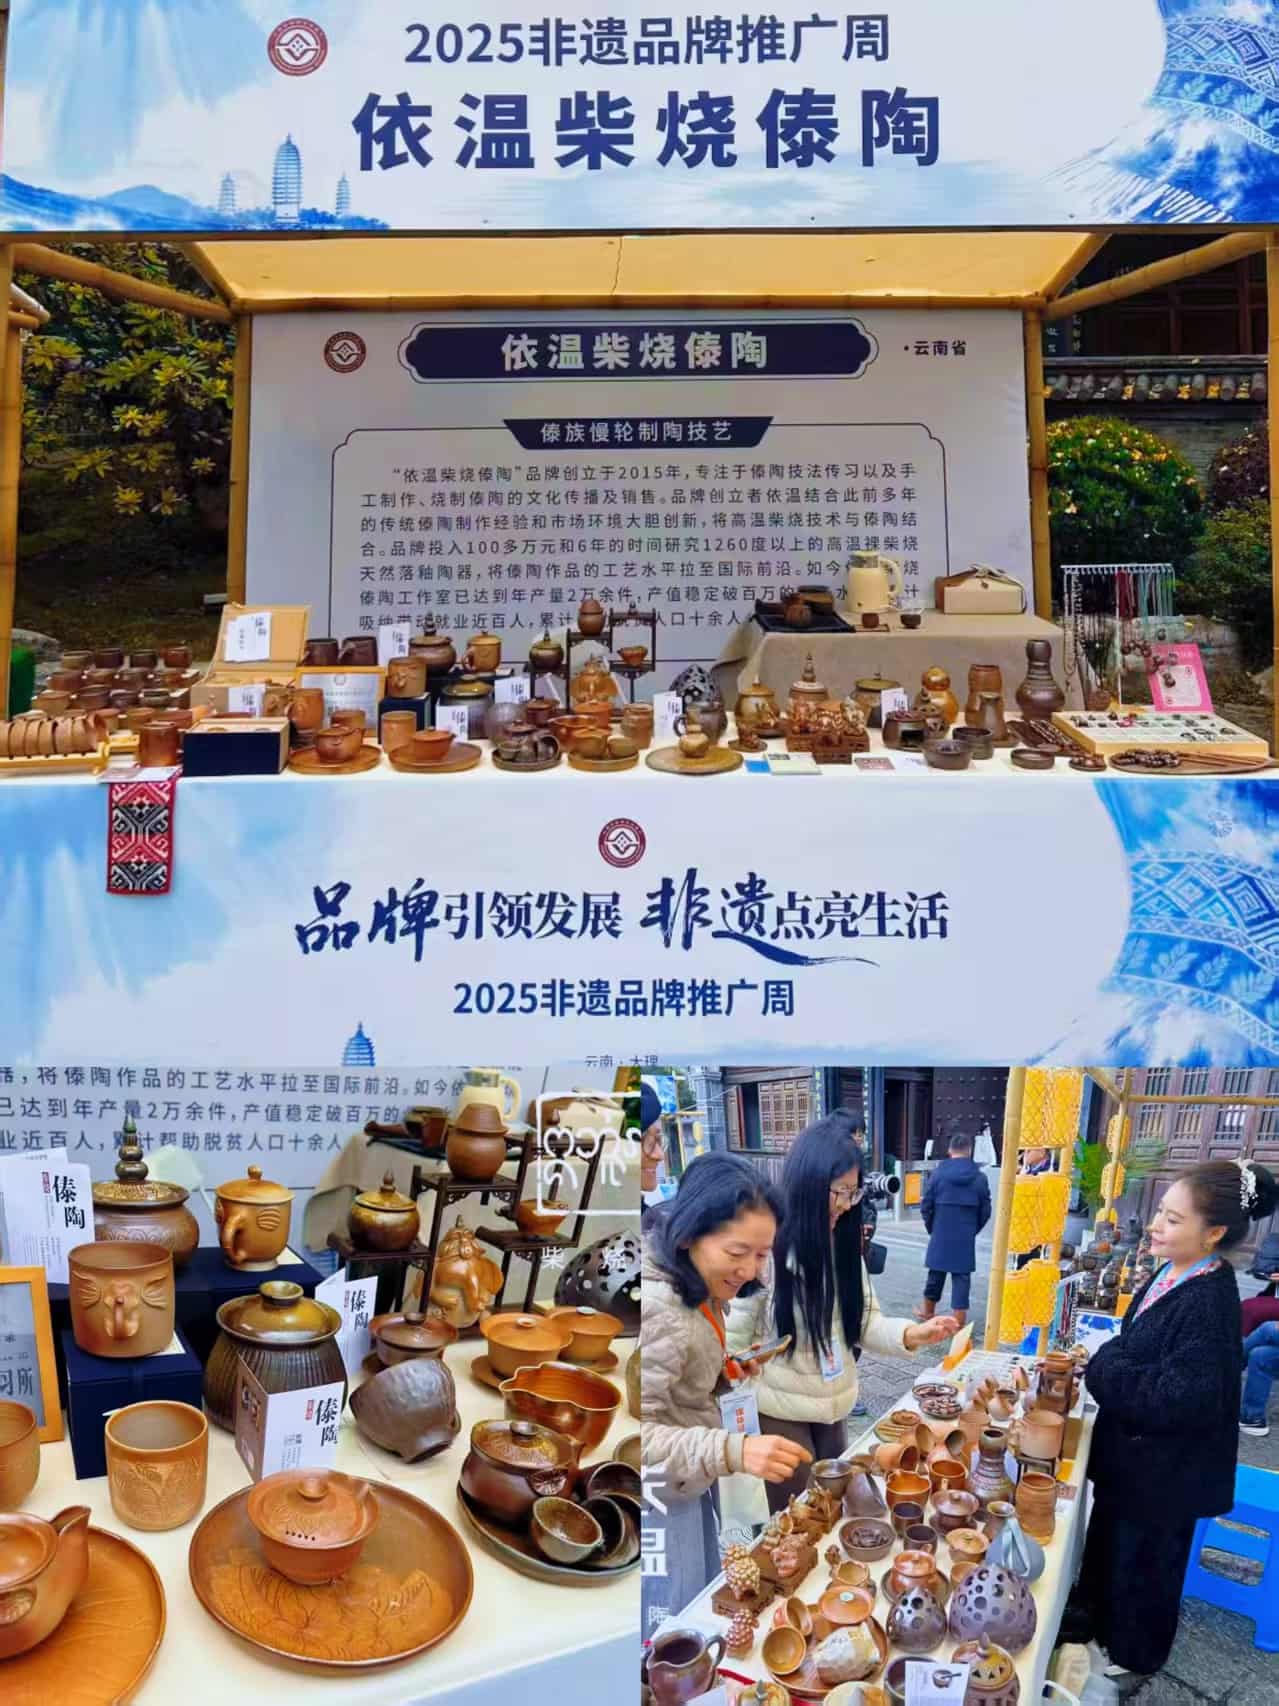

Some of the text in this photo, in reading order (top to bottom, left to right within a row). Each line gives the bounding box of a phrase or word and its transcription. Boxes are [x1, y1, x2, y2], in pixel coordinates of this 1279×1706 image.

[405, 14, 890, 68] 2025非遗品牌推广周
[352, 87, 942, 171] 依温柴烧傣陶
[501, 331, 768, 372] 依温柴烧傣陶
[540, 420, 732, 443] 傣族慢轮制陶技艺
[295, 867, 949, 967] 品牌引领发展 非遗点亮生活
[453, 979, 795, 1017] 2025非遗品牌推广周
[53, 1174, 86, 1229] 傣陶
